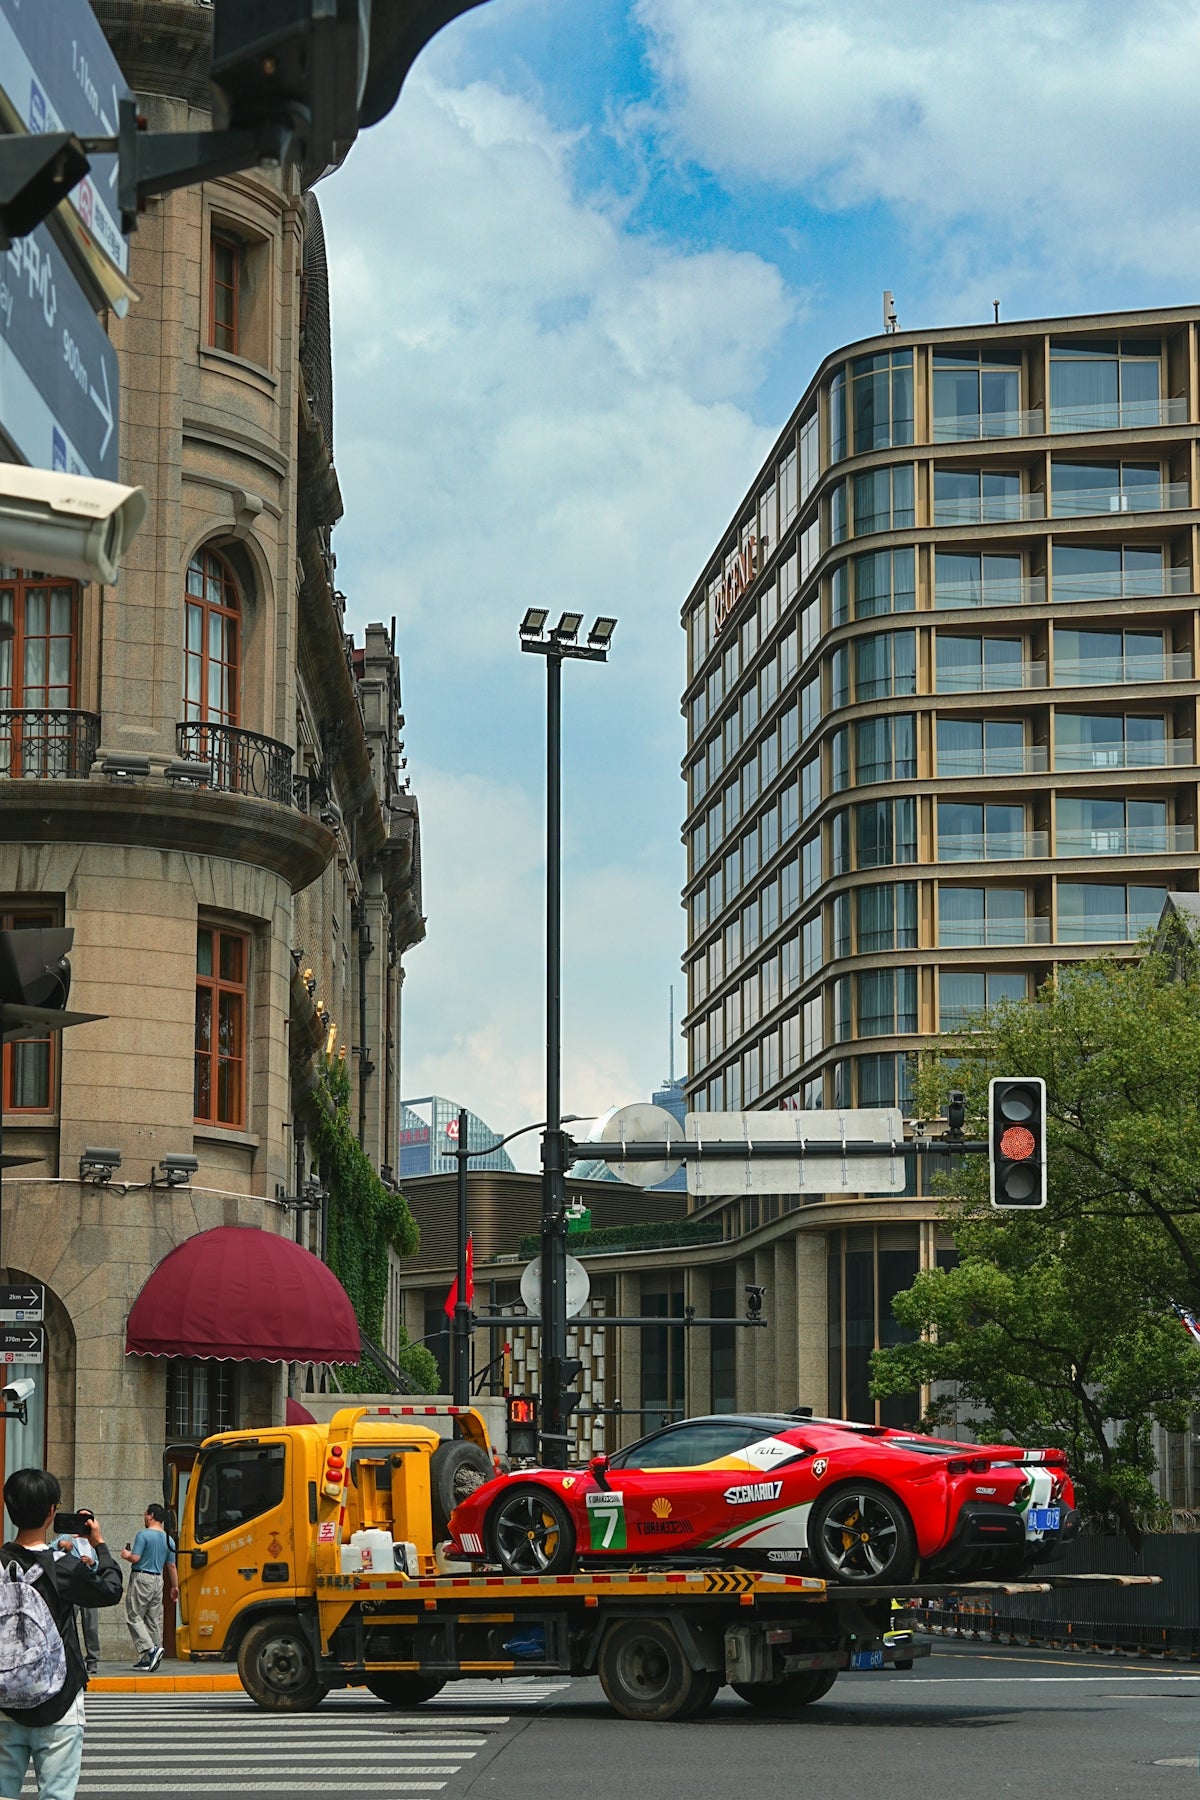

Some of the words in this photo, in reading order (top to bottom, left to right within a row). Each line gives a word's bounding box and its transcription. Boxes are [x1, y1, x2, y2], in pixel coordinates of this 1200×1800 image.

[71, 39, 99, 117] 1.1km
[62, 329, 89, 395] 900m
[593, 1508, 619, 1549] 7
